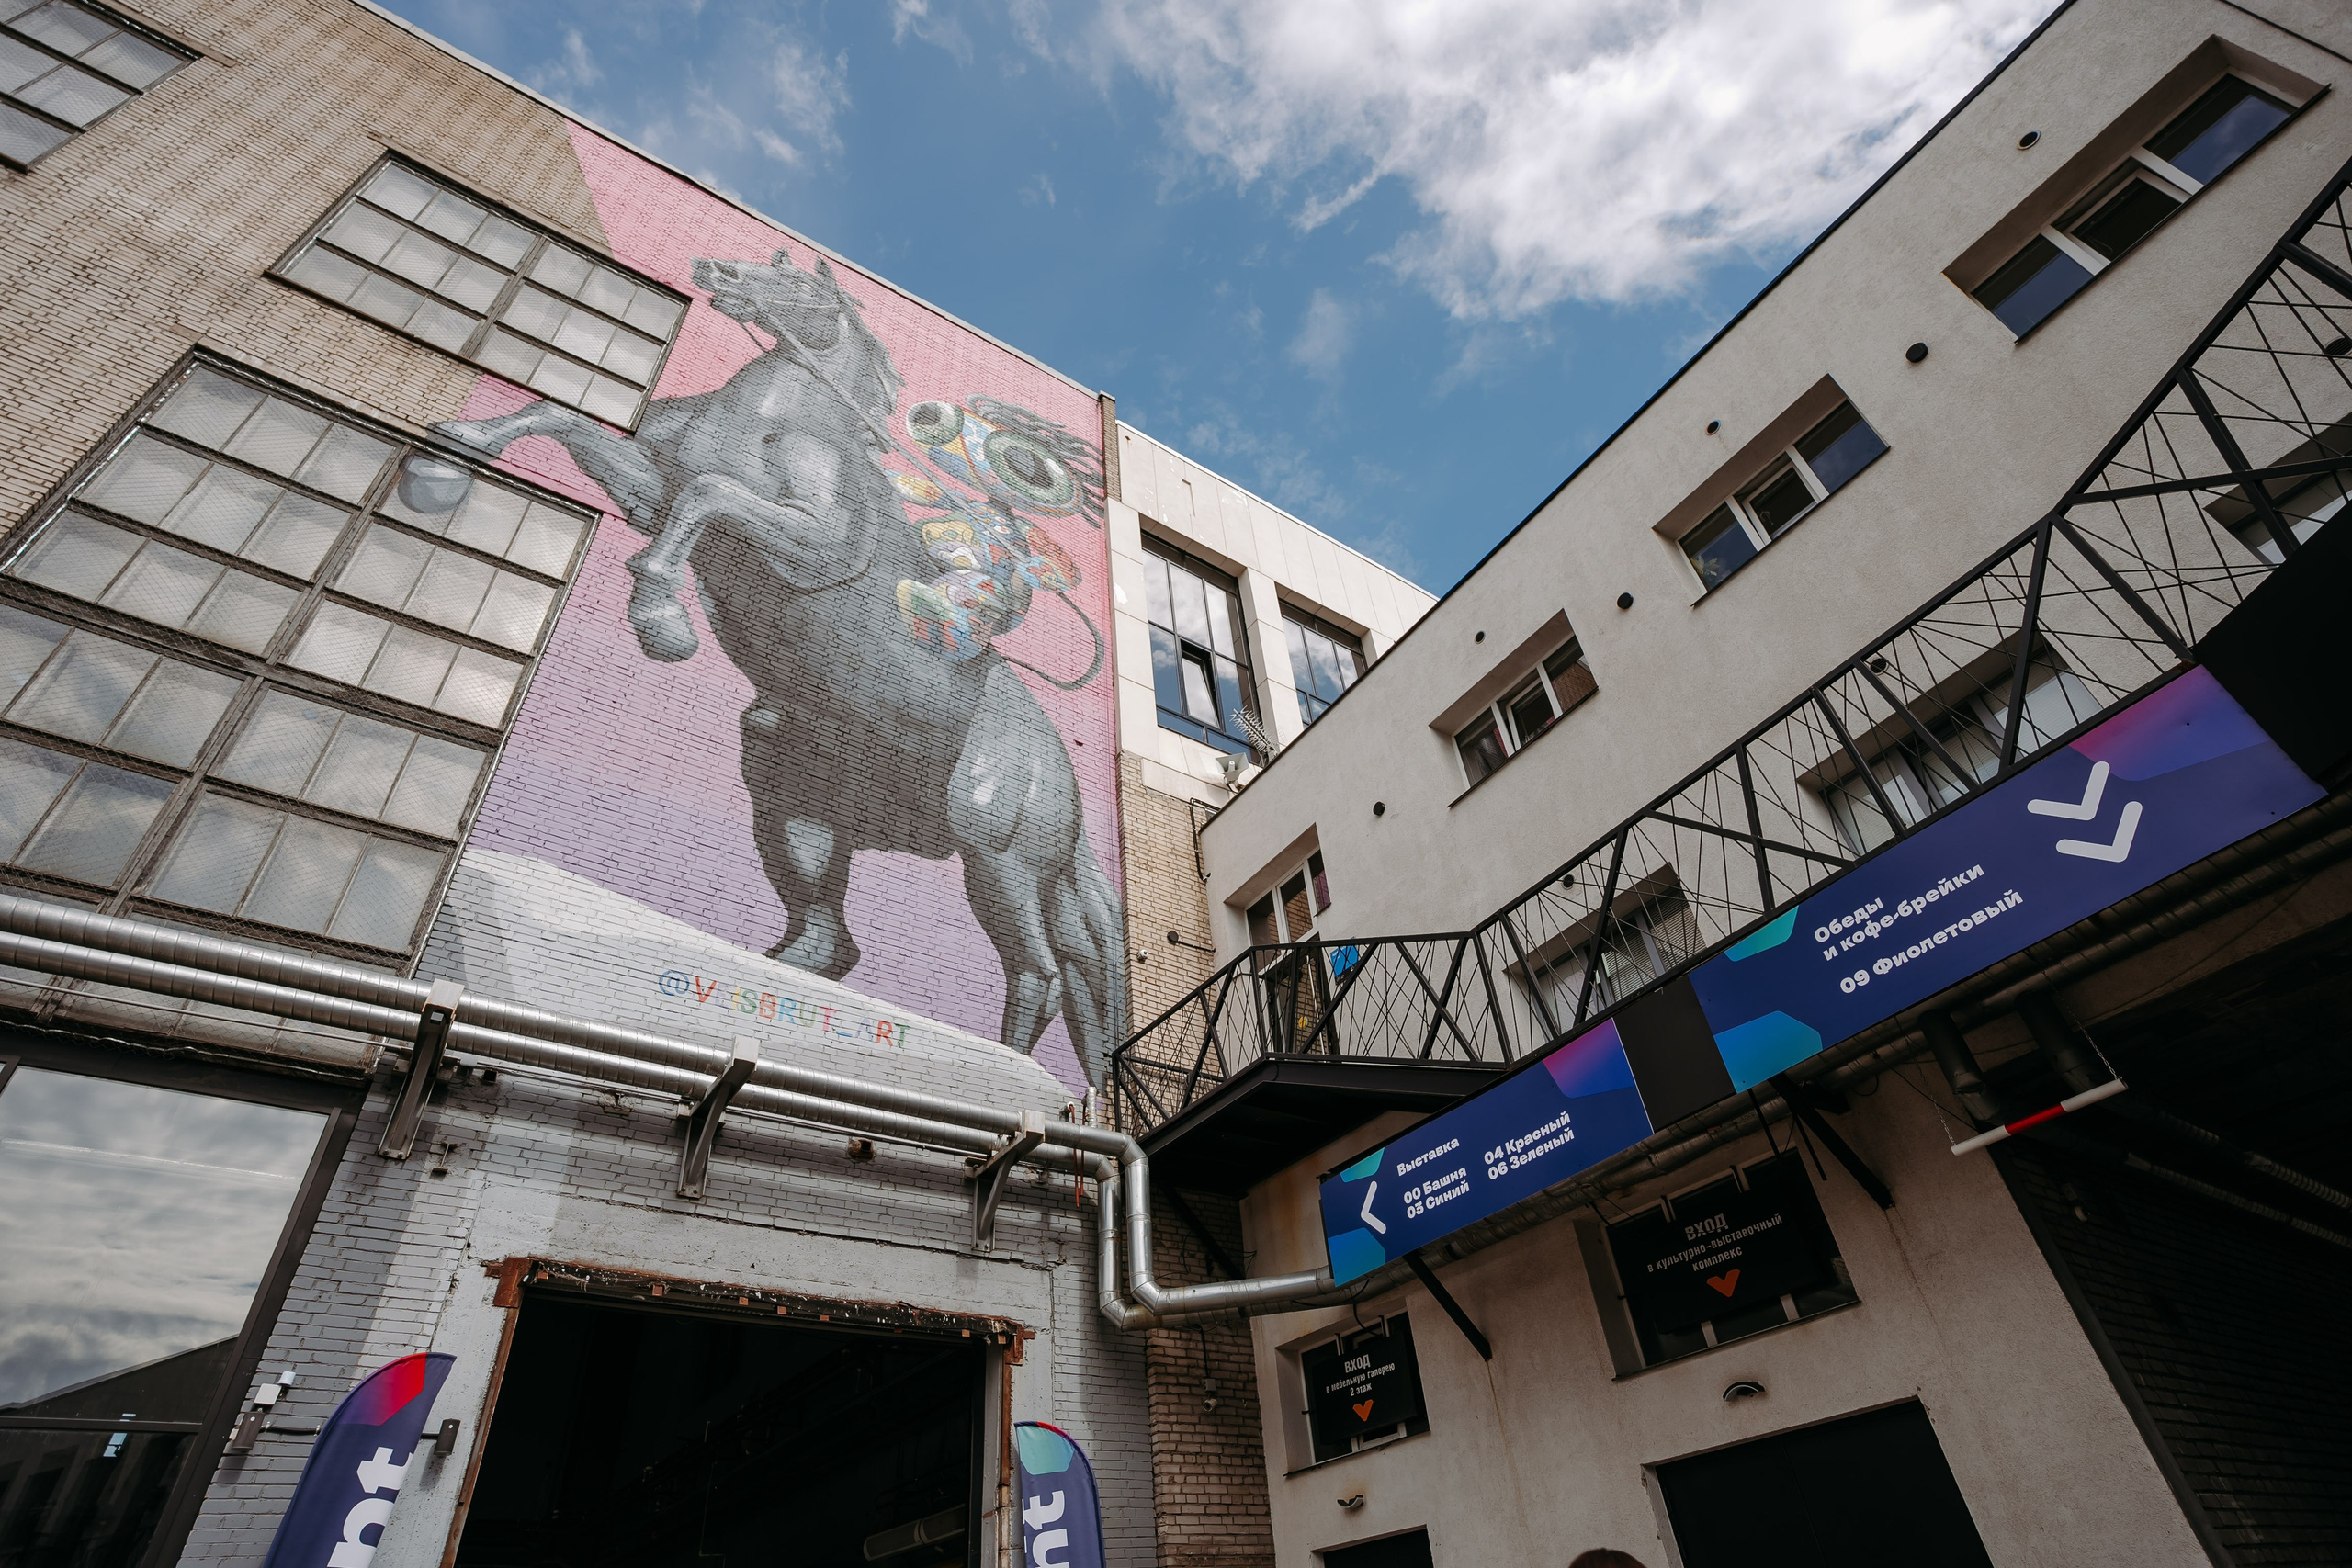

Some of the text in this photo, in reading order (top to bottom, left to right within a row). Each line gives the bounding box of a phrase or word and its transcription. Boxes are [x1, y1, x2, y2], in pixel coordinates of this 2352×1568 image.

[1814, 897, 1884, 942] Обеды
[1823, 863, 1985, 962] и кофе-брейки
[1839, 888, 2024, 994] 09 Фиолетовый
[658, 968, 911, 1049] @VEISBRUT_ART
[1396, 1138, 1460, 1177] Выставка
[1484, 1111, 1571, 1165] 04 Красный
[1487, 1127, 1575, 1180] 06 Зеленый
[1403, 1167, 1467, 1204] 00 Башня
[1407, 1180, 1470, 1219] 03 Синий
[1647, 1213, 1783, 1273] в культурно-выставочный
[1684, 1213, 1729, 1241] ВХОД
[1692, 1247, 1743, 1272] комплекс
[1331, 1373, 1366, 1392] мебельную
[1367, 1362, 1396, 1379] галерею
[1344, 1354, 1371, 1373] ВХОД
[1350, 1383, 1373, 1396] 2 этаж
